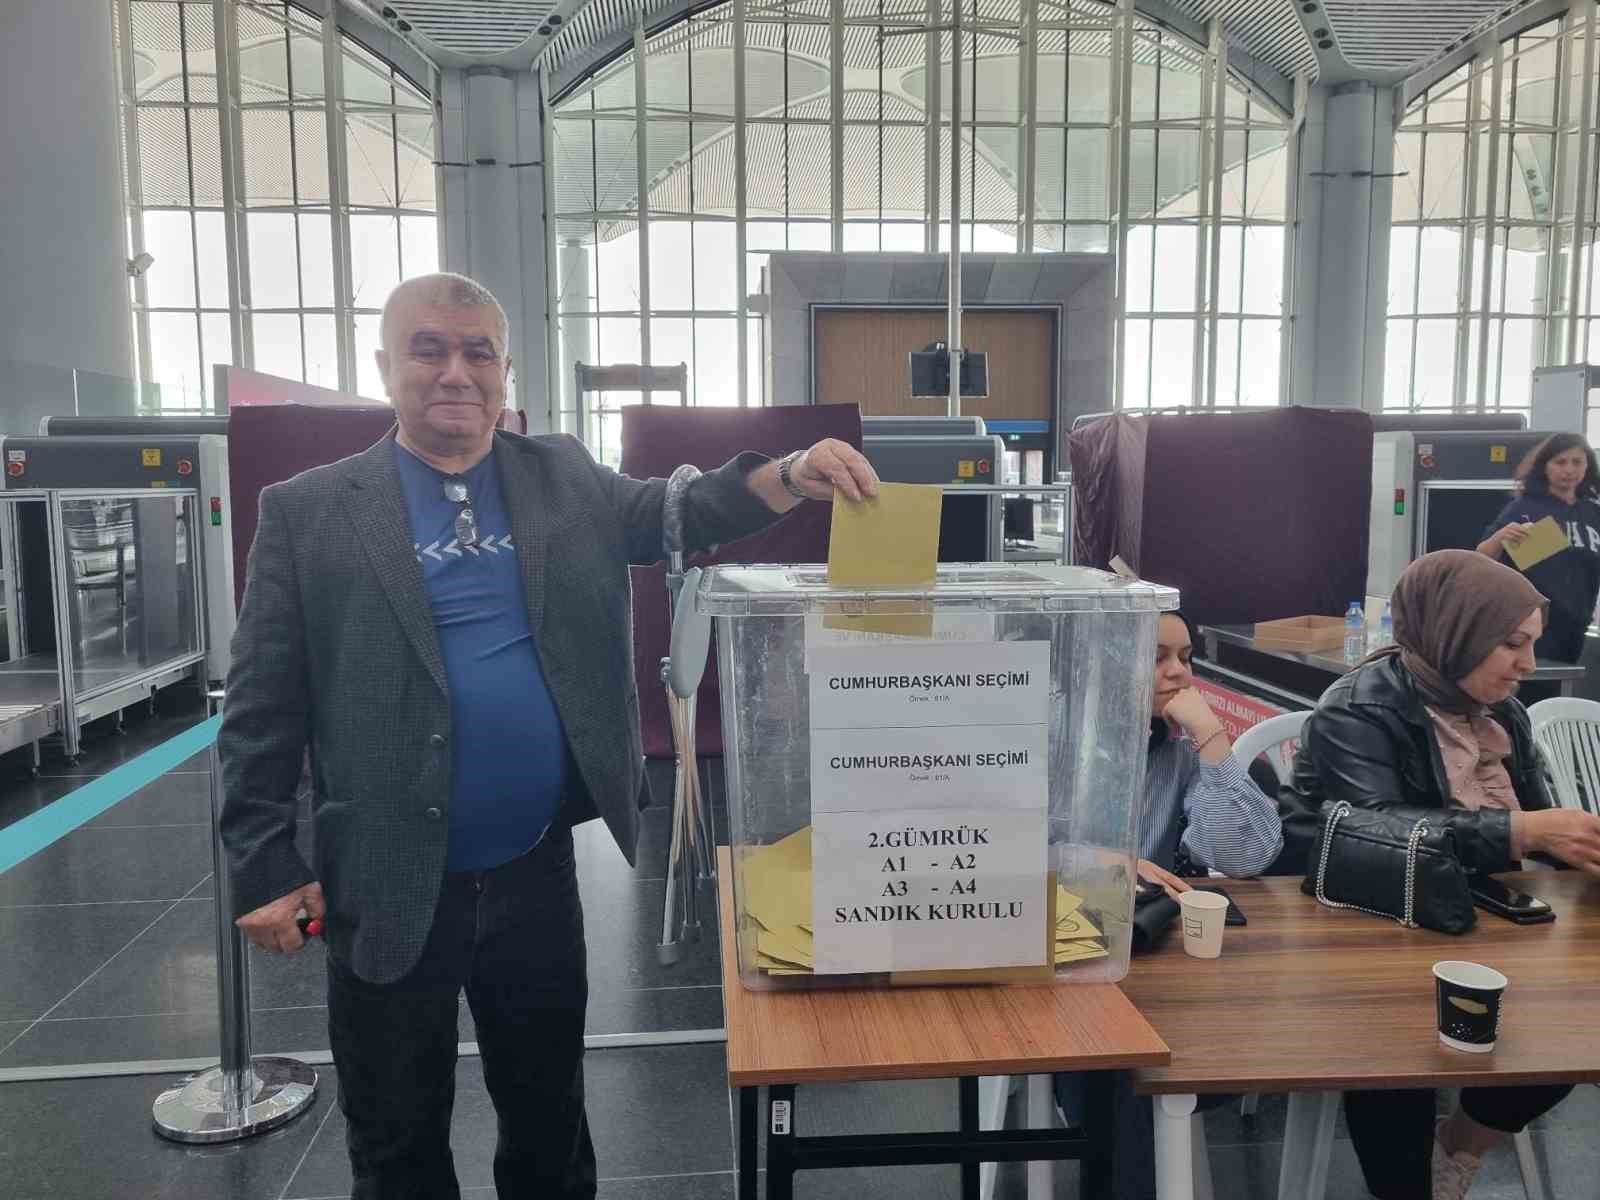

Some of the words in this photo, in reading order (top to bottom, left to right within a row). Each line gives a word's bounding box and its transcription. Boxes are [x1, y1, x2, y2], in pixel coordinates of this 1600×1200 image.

[828, 673, 971, 691] CUMHURBAŞKANI
[975, 670, 1030, 688] SEÇİMİ
[829, 754, 971, 771] CUMHURBAŞKANI
[975, 749, 1029, 768] SEÇİMİ
[868, 825, 989, 848] 2.GÜMRÜK
[881, 856, 906, 872] A1
[949, 853, 977, 870] A2
[881, 880, 909, 897] A3
[949, 878, 977, 895] A4
[834, 903, 922, 923] SANDIK
[927, 901, 1024, 920] KURULU
